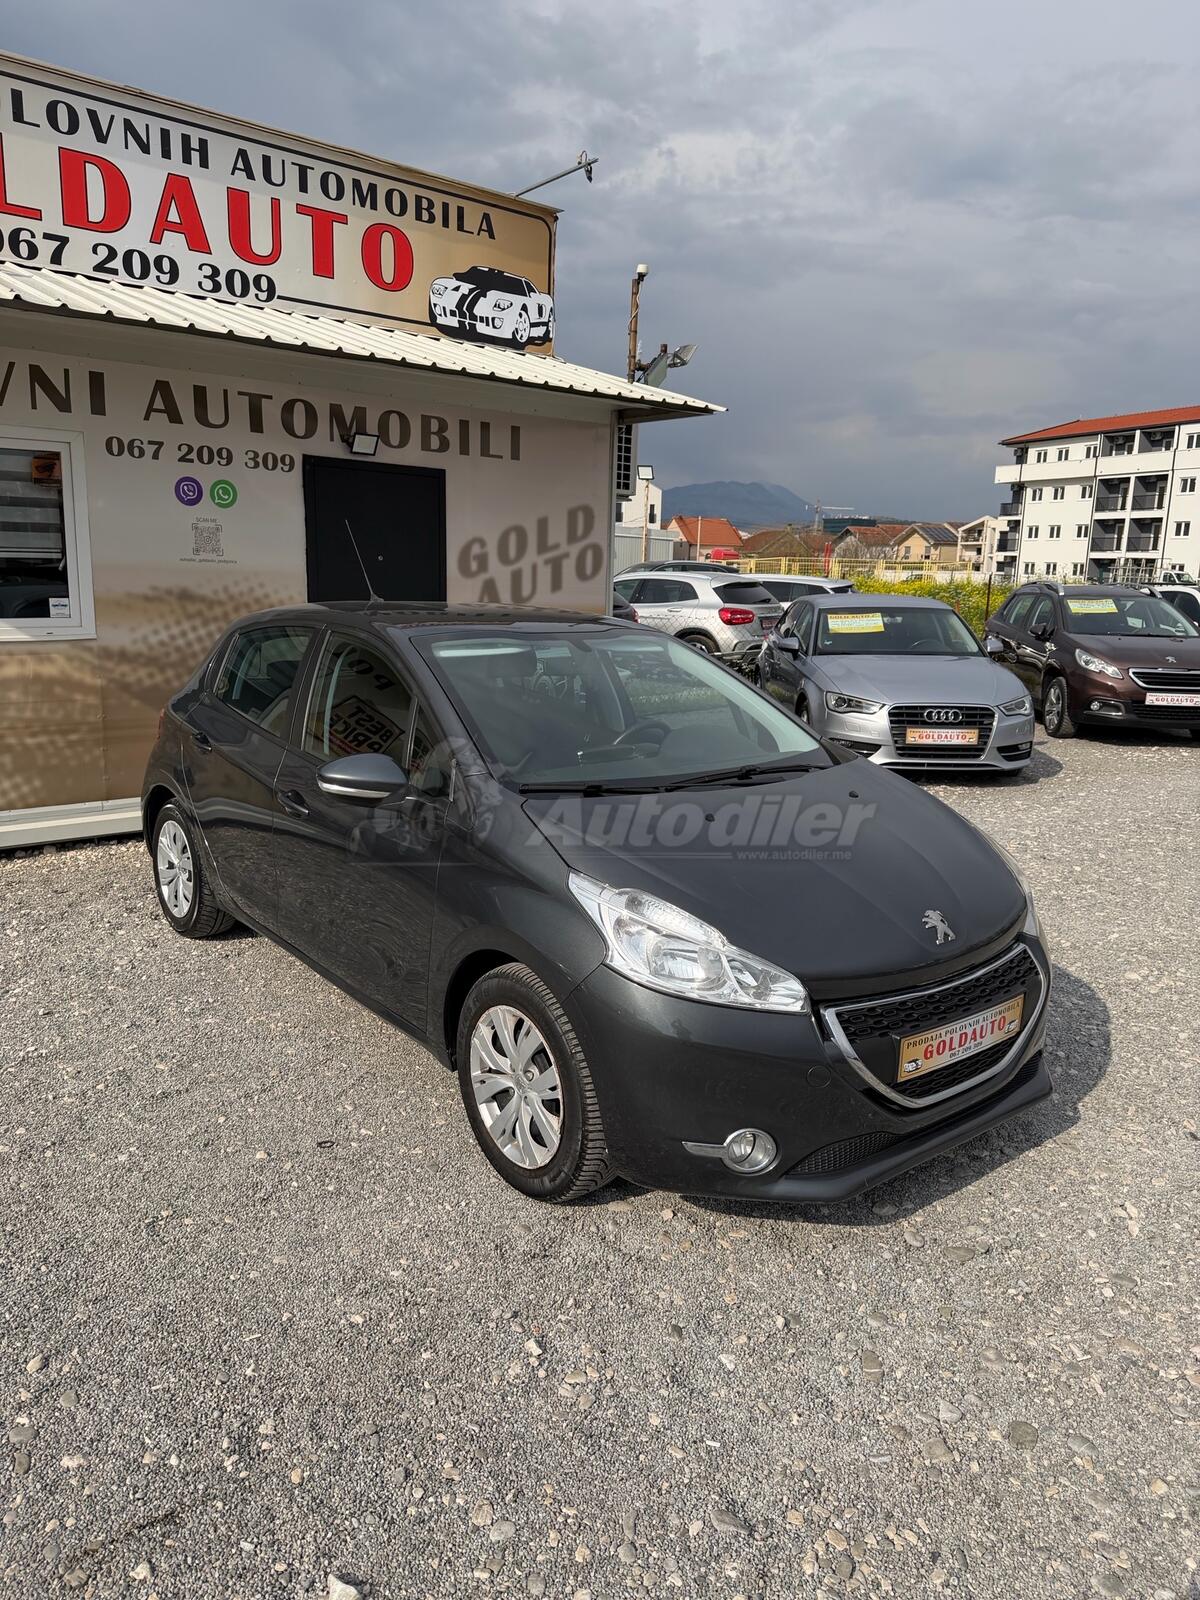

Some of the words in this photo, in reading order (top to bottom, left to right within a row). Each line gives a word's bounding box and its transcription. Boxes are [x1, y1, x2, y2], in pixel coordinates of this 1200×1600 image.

[10, 87, 210, 170] LOVNIH
[230, 148, 496, 241] AUTOMOBILA
[0, 228, 70, 266] 67
[92, 243, 180, 286] 209
[198, 263, 277, 303] 309
[105, 435, 165, 461] 067
[178, 442, 234, 467] 209
[244, 449, 296, 473] 309
[143, 379, 521, 461] AUTOMOBILI
[457, 503, 596, 579] GOLD
[478, 541, 604, 604] AUTO
[906, 1032, 943, 1050] PRODAJA
[944, 1018, 981, 1038] POLOVNIH
[982, 1002, 1021, 1023] AUTOMOBILA
[923, 1015, 1007, 1061] GOLDAUTO
